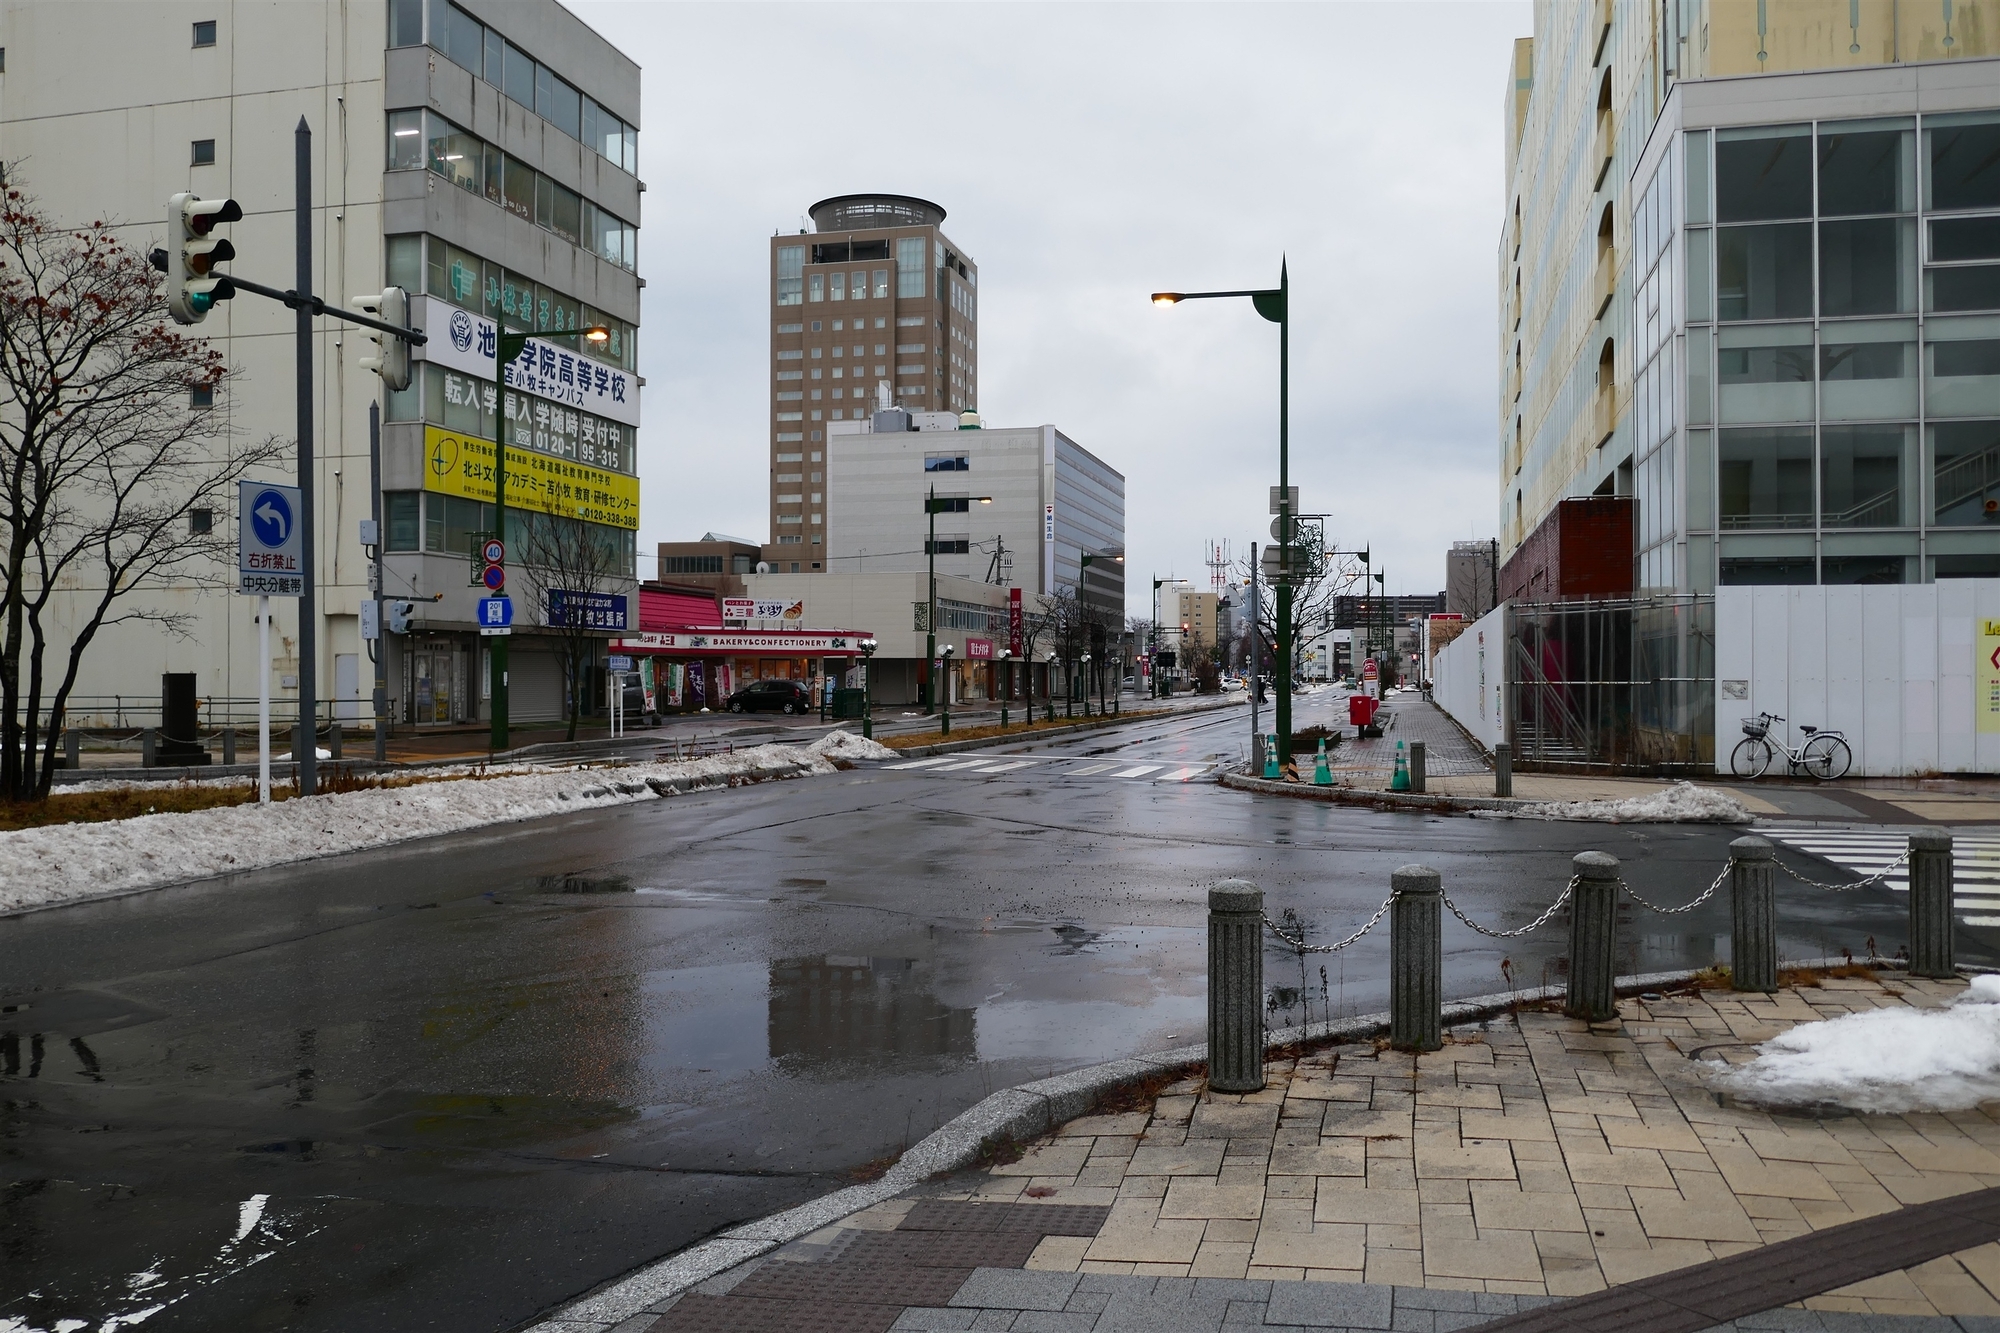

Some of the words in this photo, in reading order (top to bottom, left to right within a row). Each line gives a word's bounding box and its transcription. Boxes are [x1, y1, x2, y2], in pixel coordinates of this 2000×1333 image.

[477, 322, 626, 404] 池学院高等学校
[248, 552, 297, 570] 右折禁止
[487, 546, 500, 558] 40
[242, 575, 302, 593] 中央分離帯
